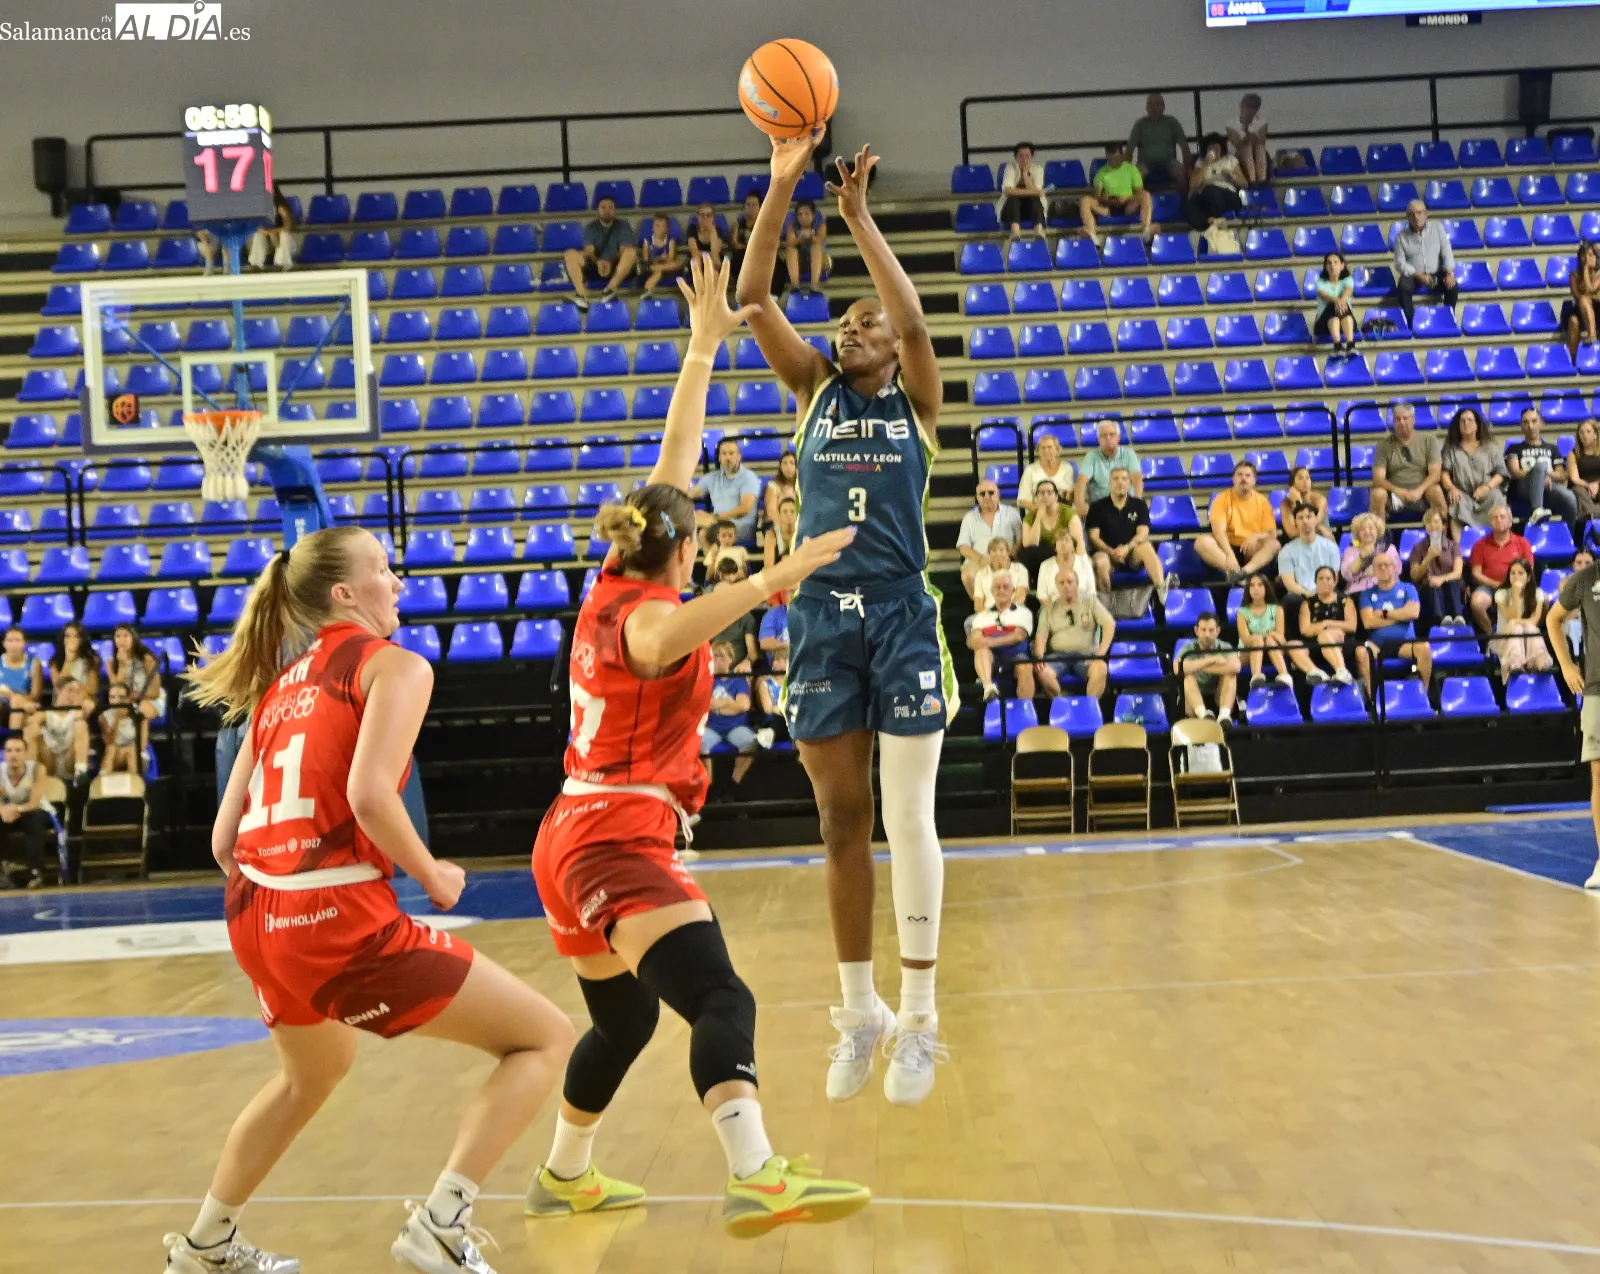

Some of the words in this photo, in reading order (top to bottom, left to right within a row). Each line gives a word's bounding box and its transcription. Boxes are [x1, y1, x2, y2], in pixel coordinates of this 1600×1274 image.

[194, 147, 256, 193] 17
[813, 453, 861, 463] CASTILLA
[863, 454, 871, 463] Y
[848, 487, 868, 522] 3
[238, 732, 315, 834] 11
[301, 837, 322, 849] 2027
[291, 906, 338, 927] HOLLAND
